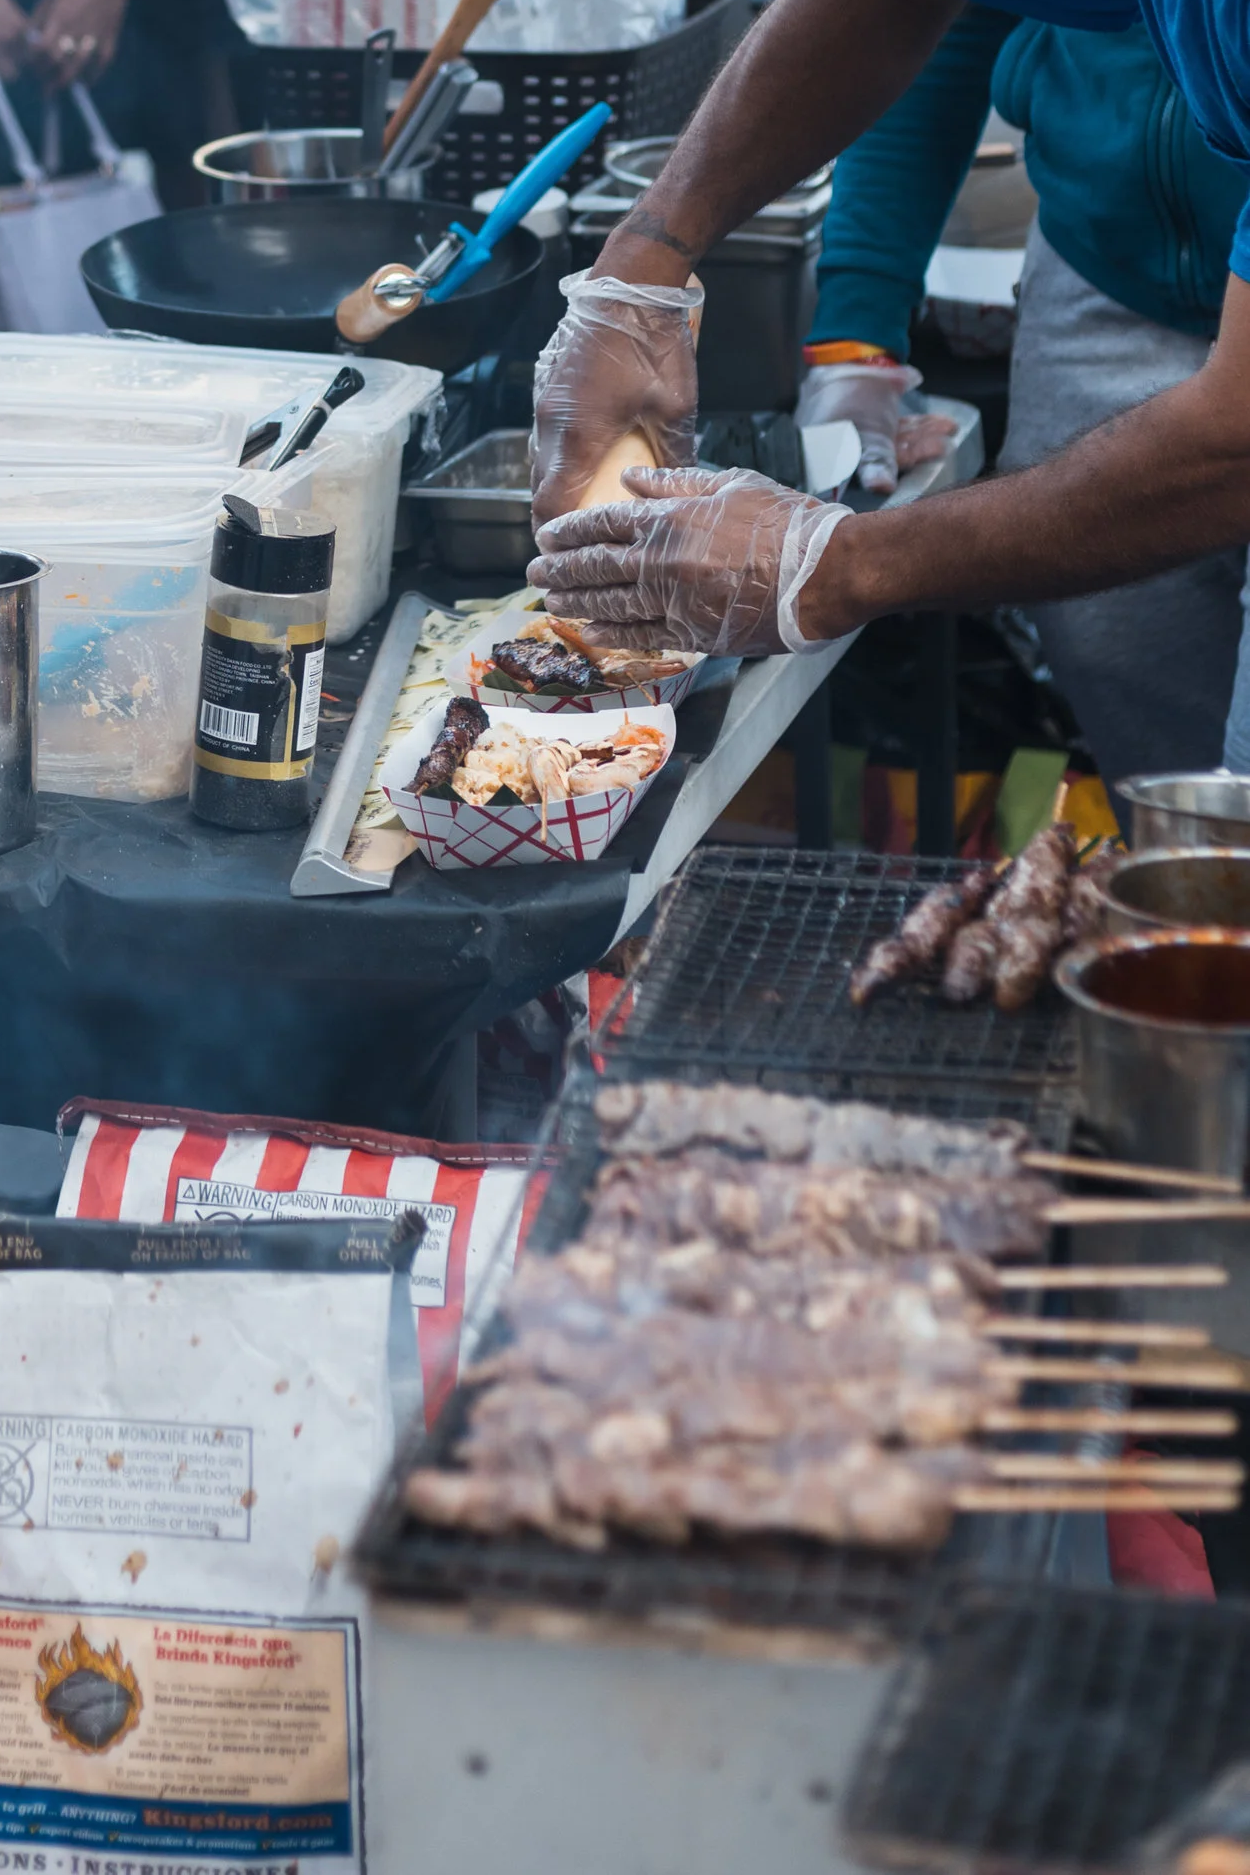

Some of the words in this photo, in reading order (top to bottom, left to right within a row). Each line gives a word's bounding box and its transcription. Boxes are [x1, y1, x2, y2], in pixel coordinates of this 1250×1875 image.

[231, 744, 251, 753] CHINA
[200, 1183, 274, 1211] WARNING
[278, 1194, 328, 1212] CARBON
[332, 1197, 400, 1218] MONOXIDE
[7, 1236, 34, 1248] END
[347, 1238, 378, 1251] PULL
[15, 1249, 42, 1261] BAG
[55, 1424, 114, 1441] CARBON
[118, 1427, 188, 1445] MONOXIDE
[53, 1494, 104, 1510] NEVER
[153, 1627, 171, 1642] La
[176, 1628, 257, 1649] Diferencia
[261, 1637, 293, 1654] que
[156, 1646, 209, 1665] Brinda
[2, 1801, 15, 1813] to
[17, 1803, 47, 1818] grill
[60, 1803, 137, 1825] ANYTHING?
[143, 1807, 334, 1833] Kingsford.com
